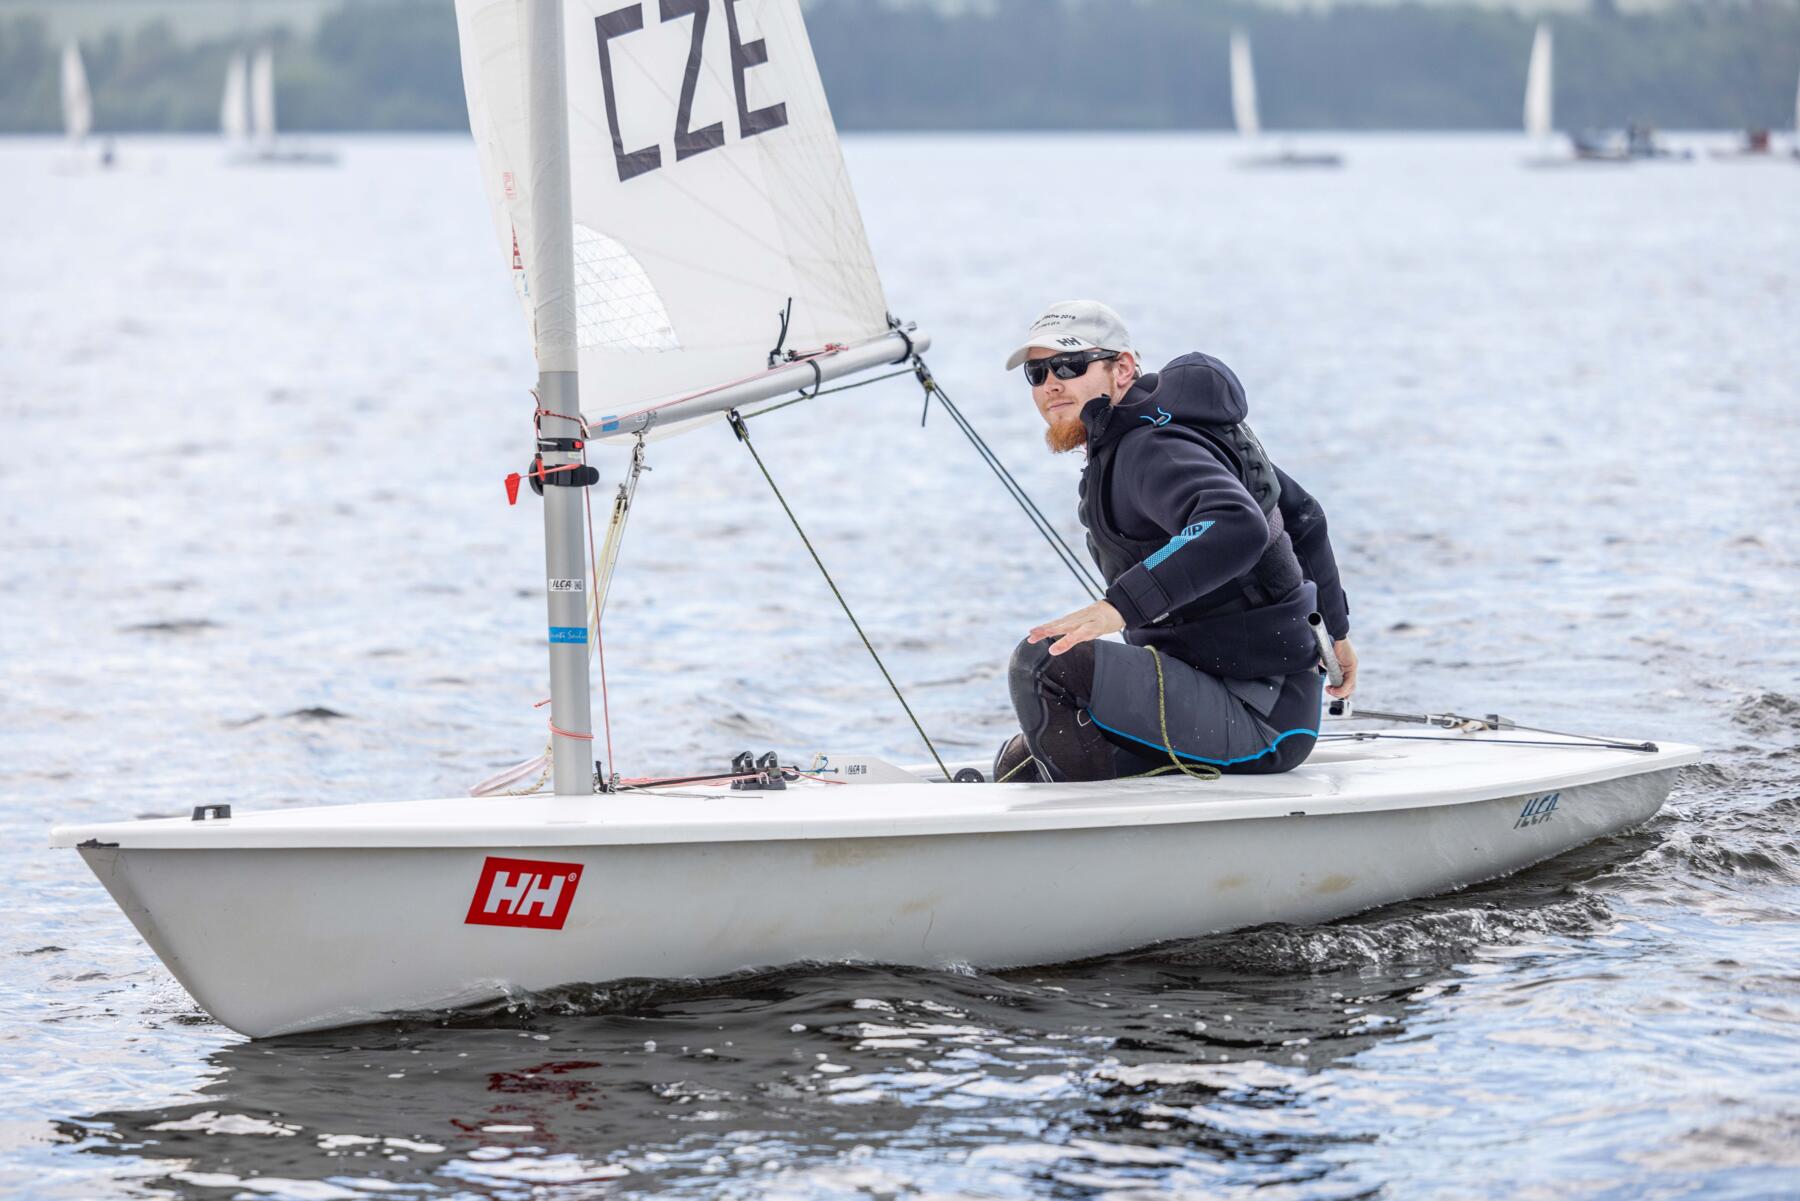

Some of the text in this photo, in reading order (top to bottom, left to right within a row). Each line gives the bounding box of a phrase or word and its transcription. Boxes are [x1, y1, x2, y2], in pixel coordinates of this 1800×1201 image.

[595, 0, 788, 182] CZE
[1056, 337, 1082, 347] HH
[553, 579, 572, 588] ILCA
[483, 870, 566, 917] HH
